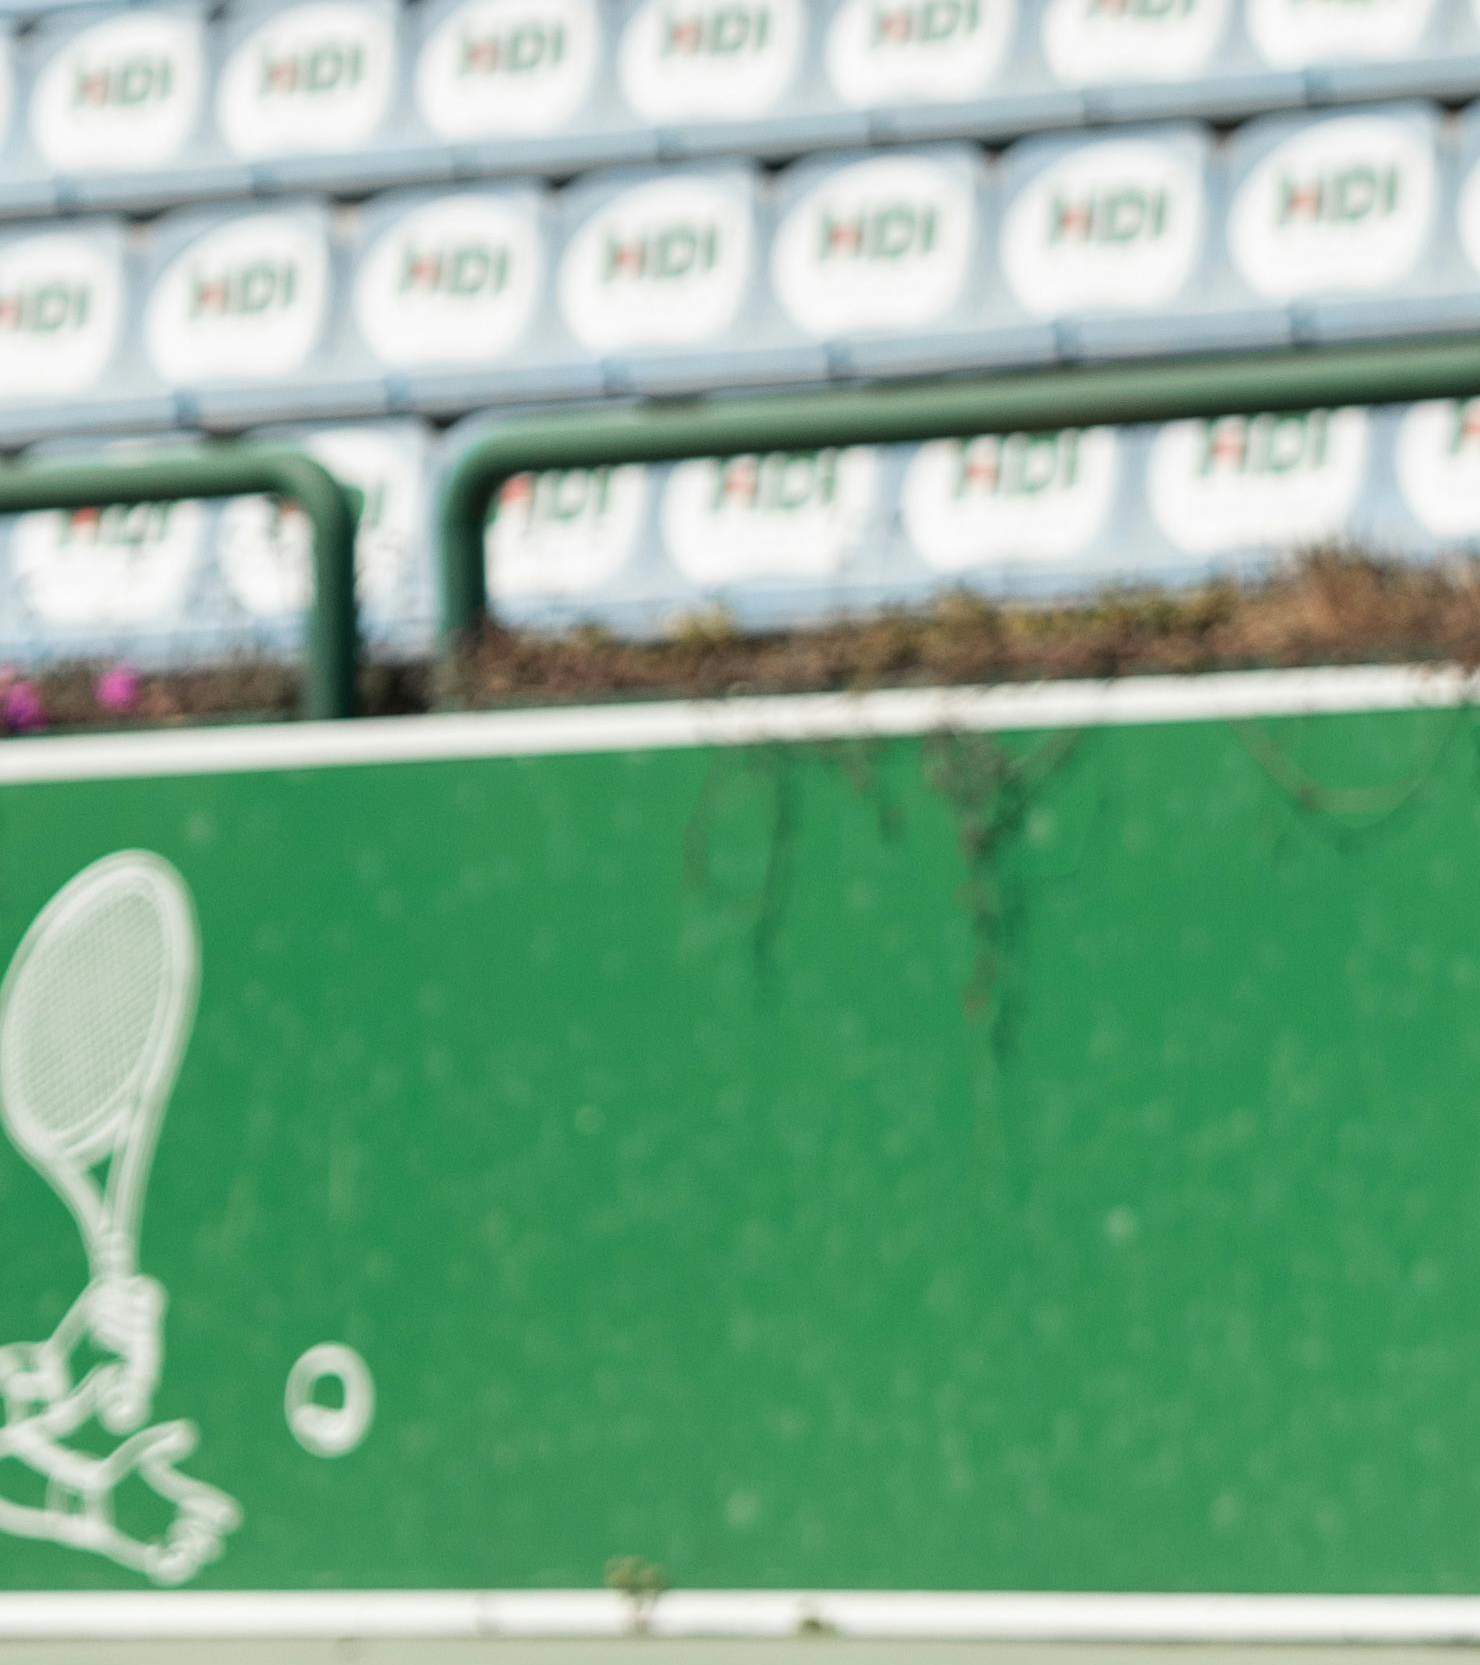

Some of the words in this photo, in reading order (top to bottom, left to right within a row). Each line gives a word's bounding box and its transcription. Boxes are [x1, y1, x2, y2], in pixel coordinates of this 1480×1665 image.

[460, 23, 564, 81] HDI
[660, 0, 767, 65] HDI
[73, 55, 172, 111] HDI
[260, 42, 365, 100] HDI
[1048, 188, 1168, 247] HDI
[1278, 166, 1397, 230] HDI
[604, 225, 716, 283] HDI
[814, 201, 938, 261] HDI
[189, 261, 297, 319] HDI
[399, 241, 509, 296] HDI
[953, 430, 1080, 497] HDI
[1198, 409, 1327, 475] HDI
[711, 457, 835, 516] HDI
